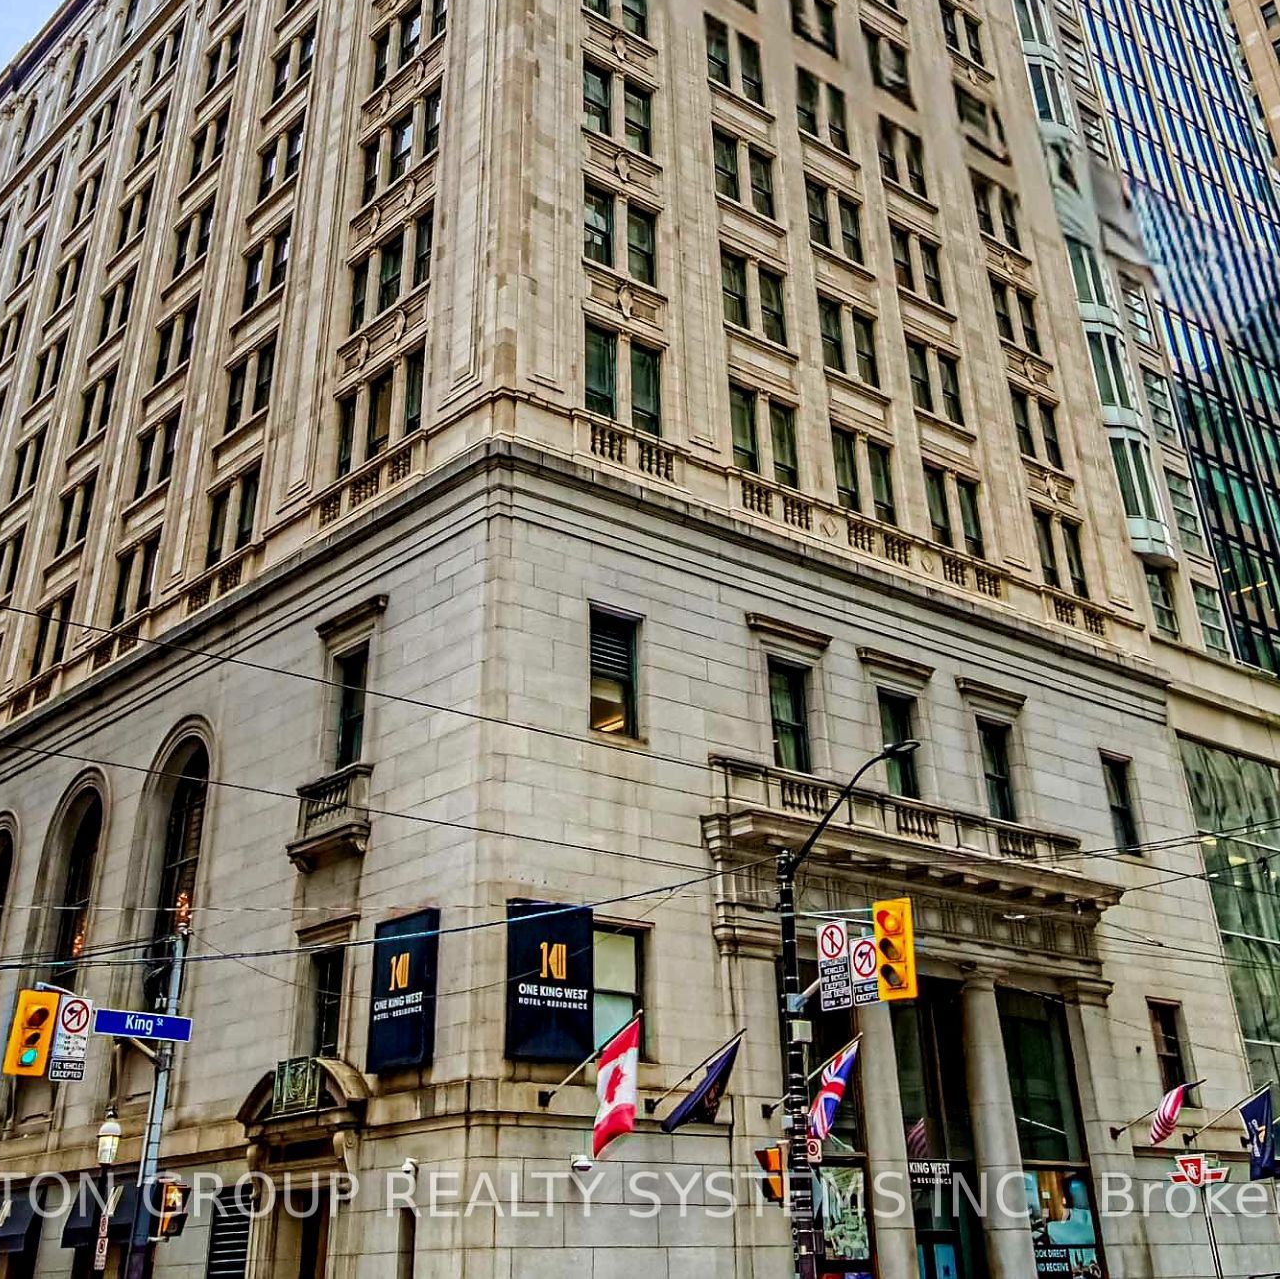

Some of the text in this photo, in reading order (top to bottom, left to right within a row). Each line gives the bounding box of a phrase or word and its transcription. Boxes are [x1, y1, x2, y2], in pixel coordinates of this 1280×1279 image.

[519, 983, 588, 1000] ONE KING WEST
[374, 991, 423, 1011] ONE KING WEST
[519, 997, 588, 1010] HOTEL RESIDENCE
[125, 1014, 164, 1035] King St
[909, 1162, 950, 1175] KING WEST
[1048, 1248, 1067, 1258] DIRECT
[1046, 1262, 1069, 1272] RECEIVE
